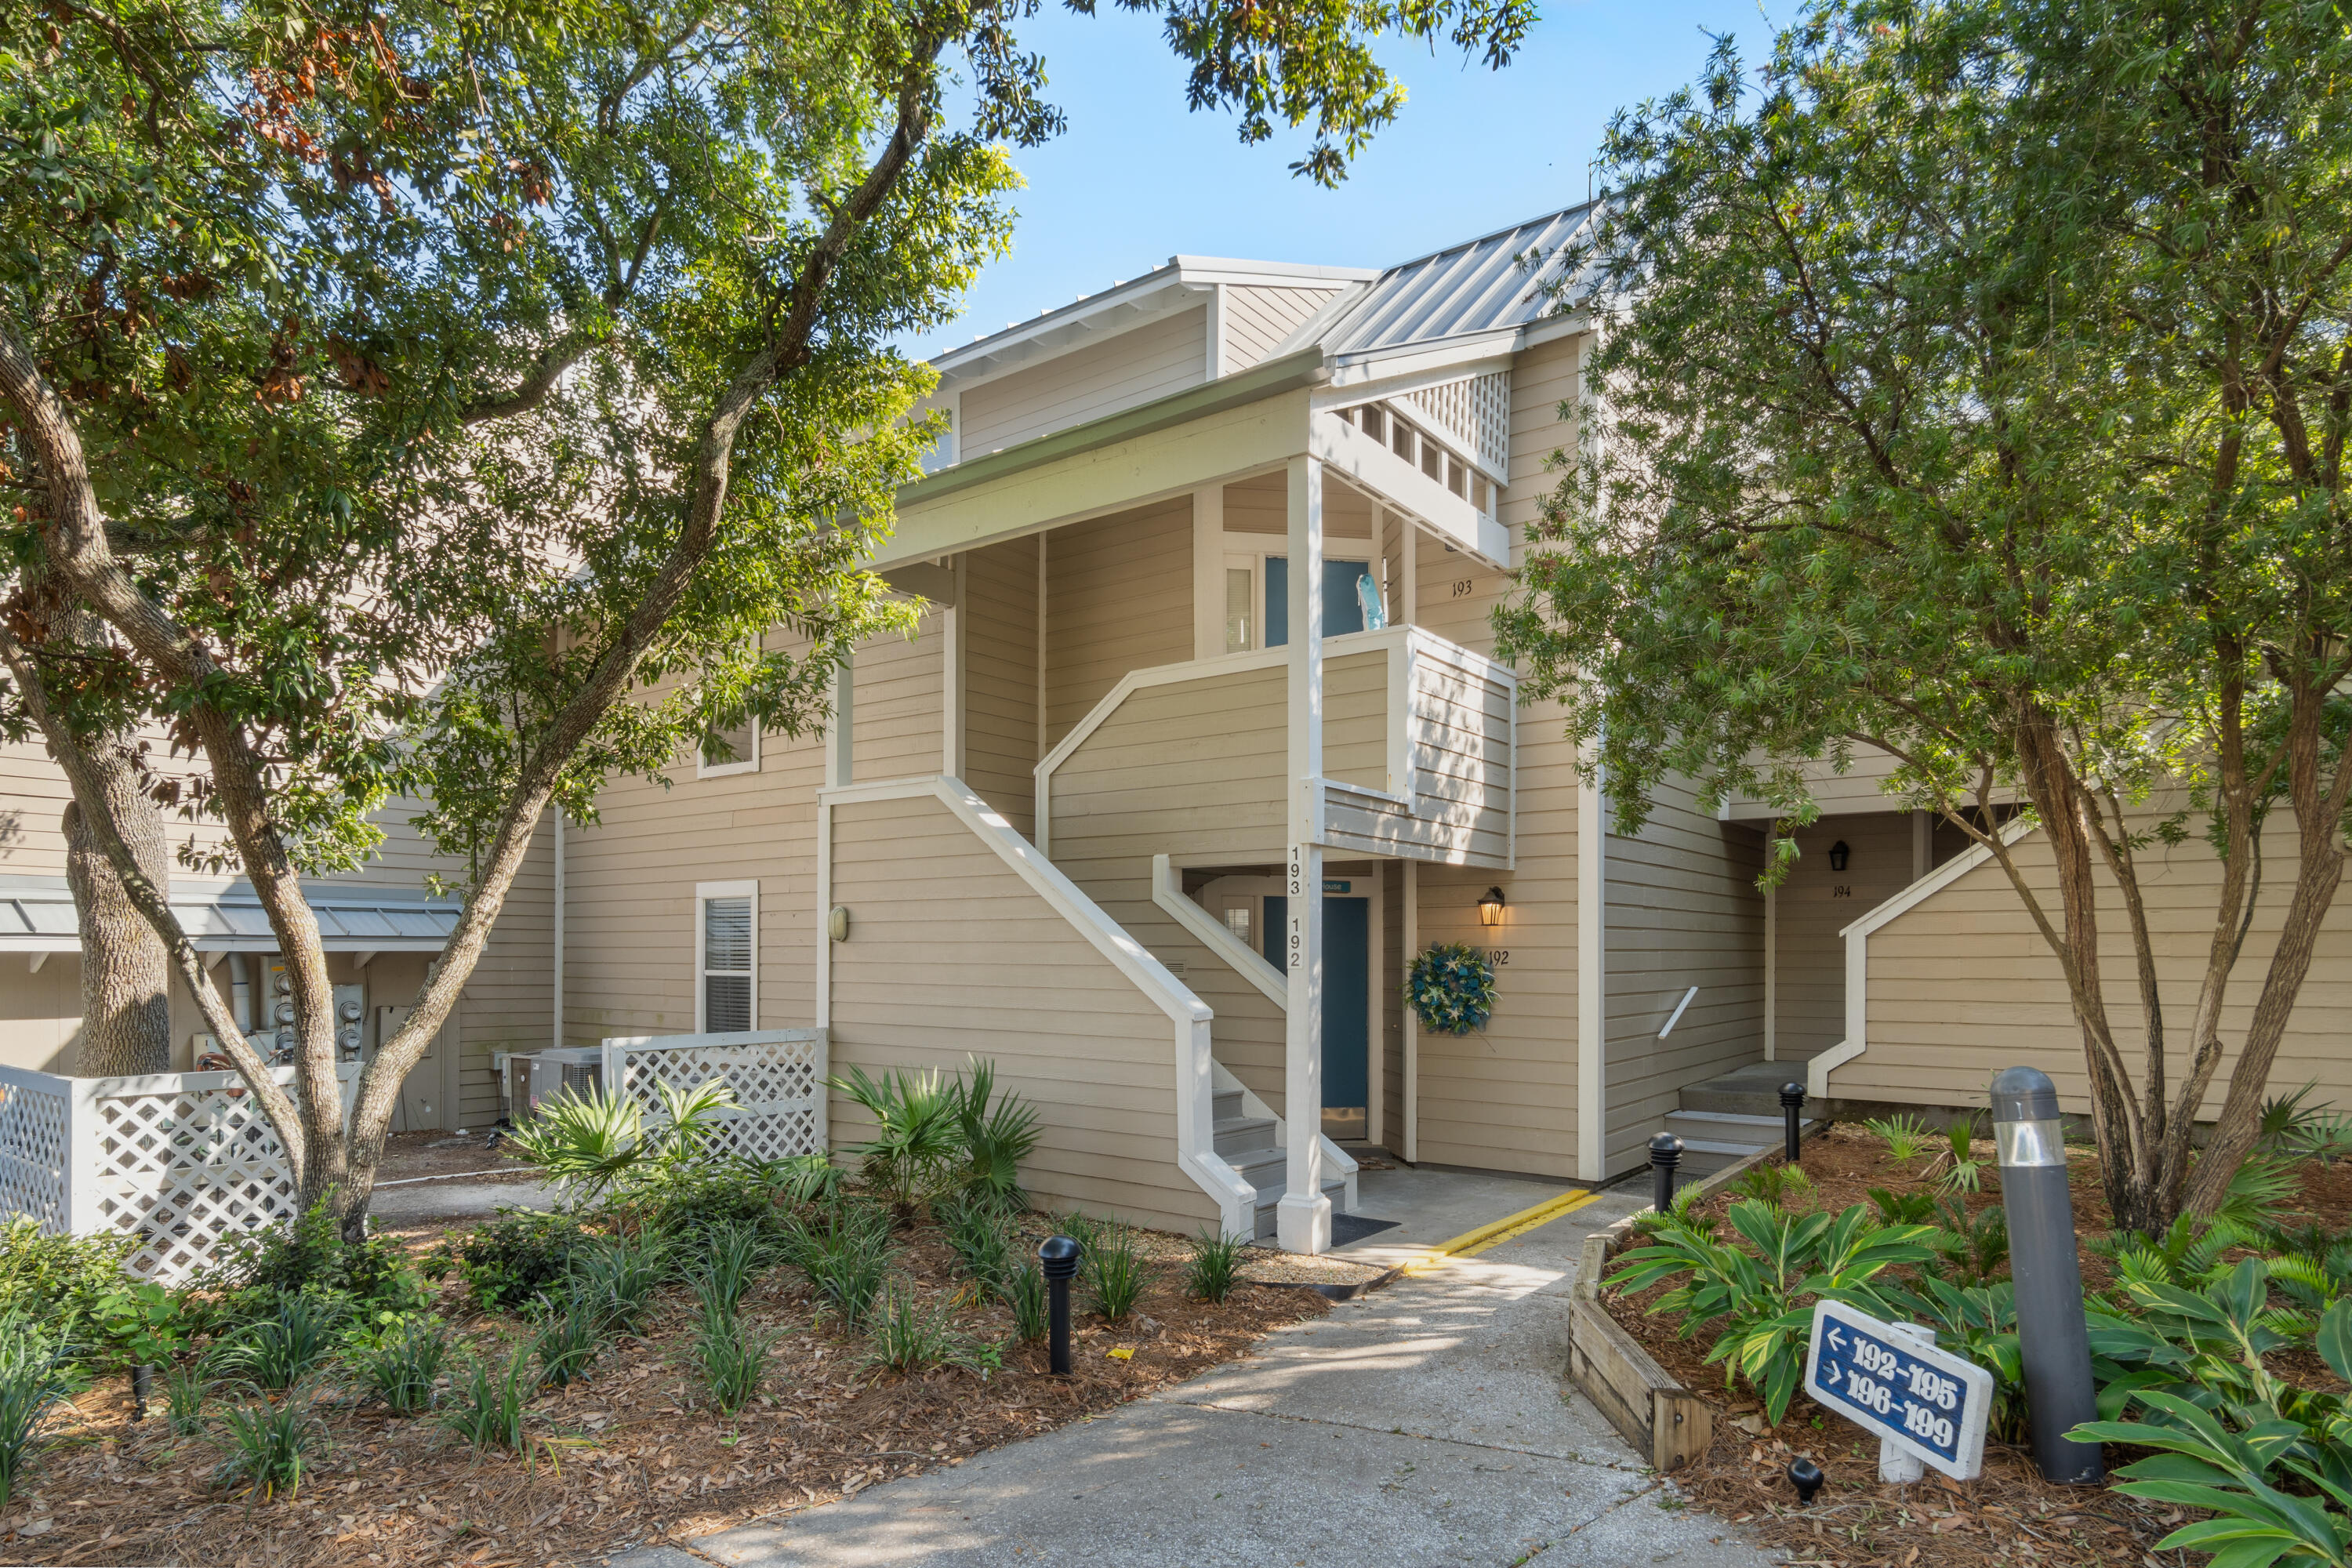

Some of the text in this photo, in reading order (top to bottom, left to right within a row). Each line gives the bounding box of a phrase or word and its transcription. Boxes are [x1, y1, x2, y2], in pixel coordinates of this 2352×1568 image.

[1452, 579, 1472, 598] 193
[1290, 846, 1300, 895] 193
[1833, 885, 1851, 898] 194
[1290, 918, 1300, 967] 192
[1490, 950, 1509, 966] 192
[1852, 1336, 1958, 1410] 192-195
[1846, 1370, 1954, 1447] 196-199
